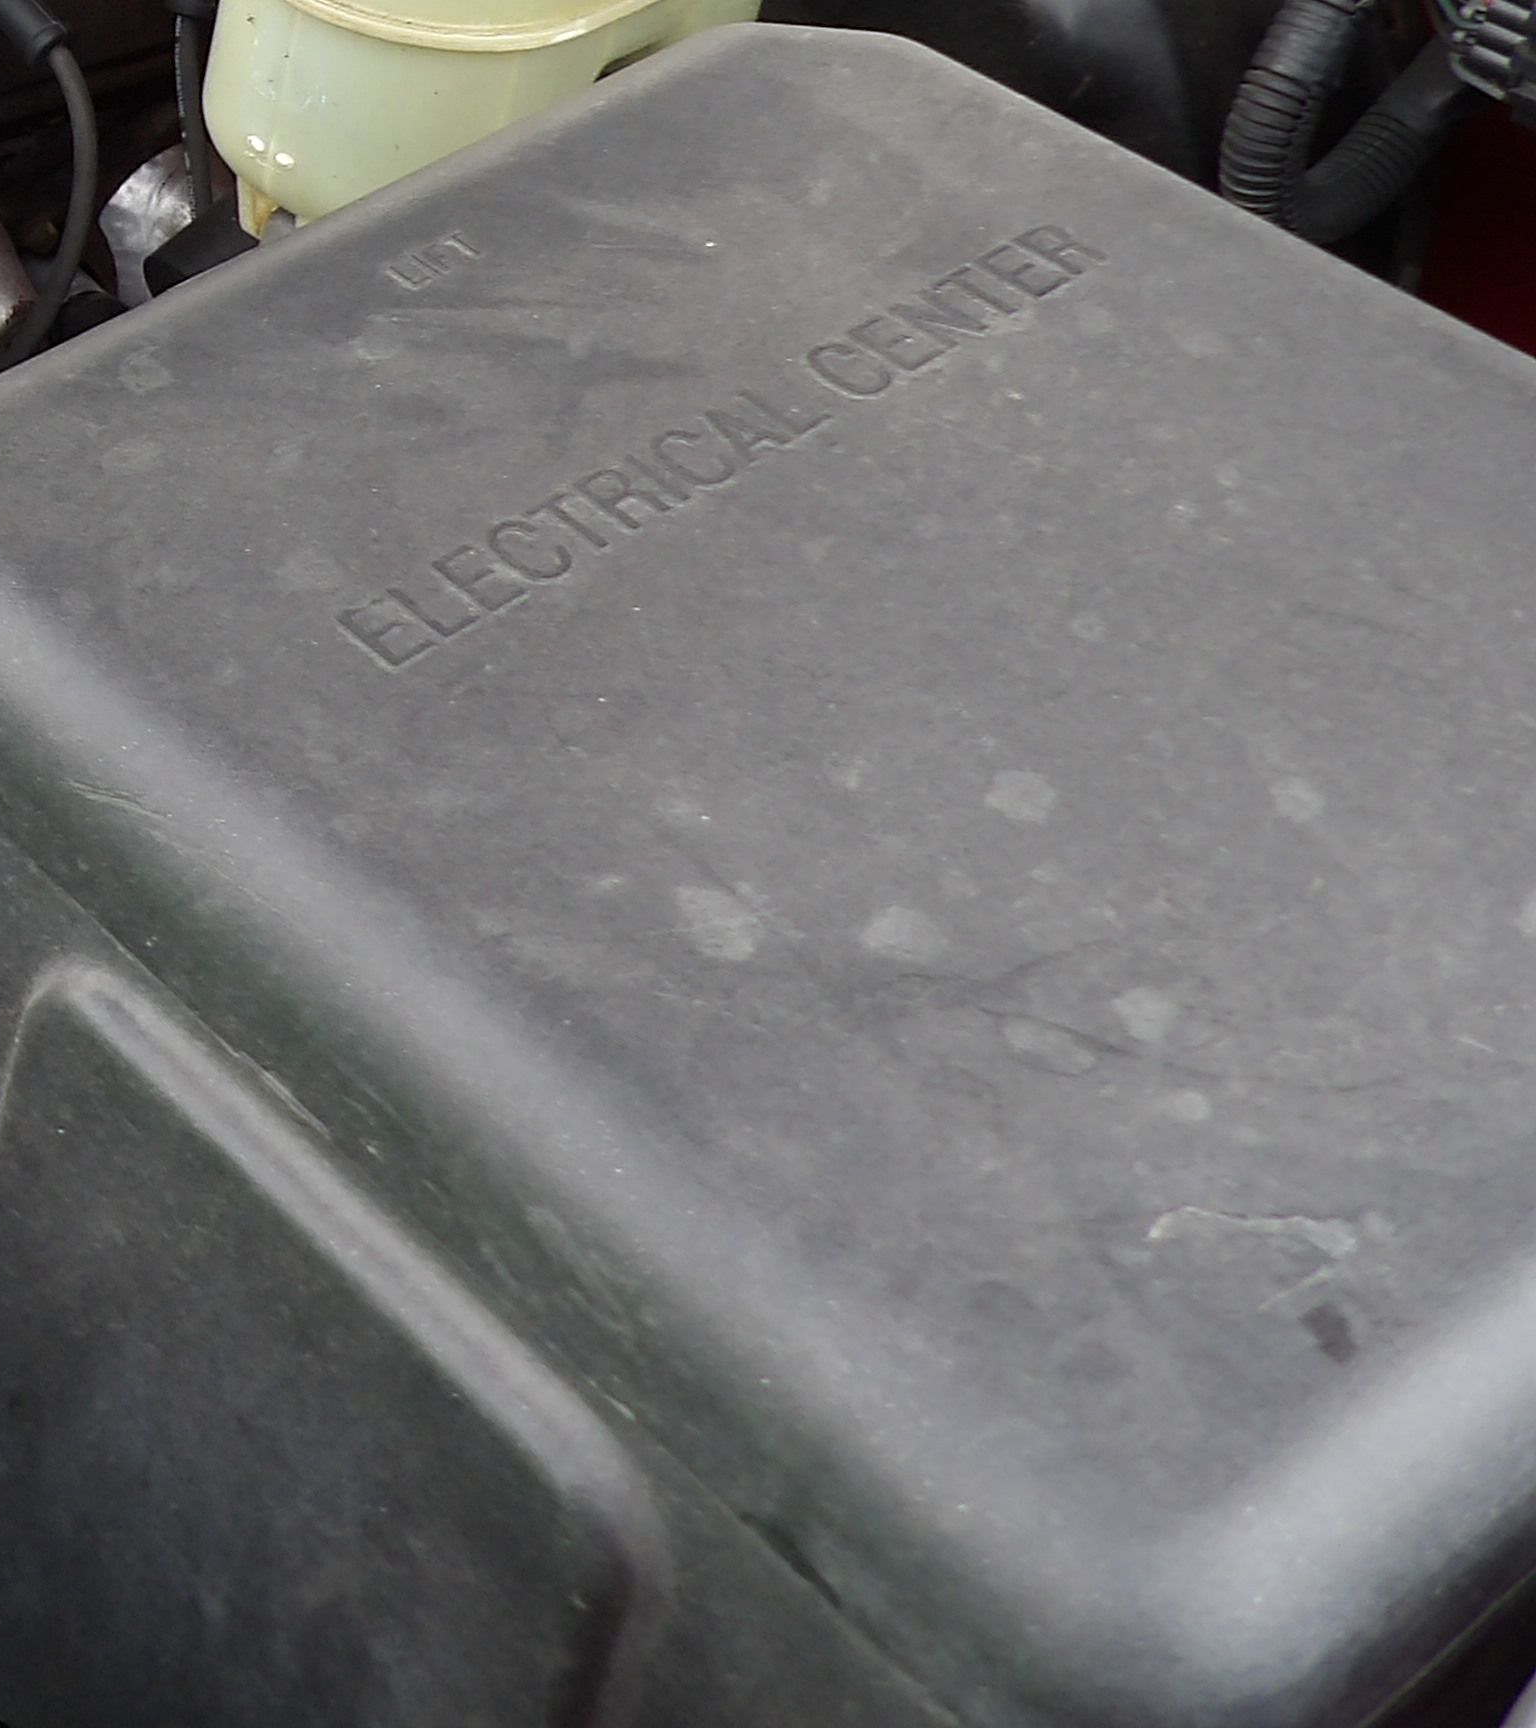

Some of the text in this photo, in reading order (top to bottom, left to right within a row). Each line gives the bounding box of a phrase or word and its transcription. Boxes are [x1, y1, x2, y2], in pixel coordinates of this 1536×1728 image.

[386, 229, 484, 291] LIFT
[333, 220, 1112, 674] ELECTRICAL CENTER
